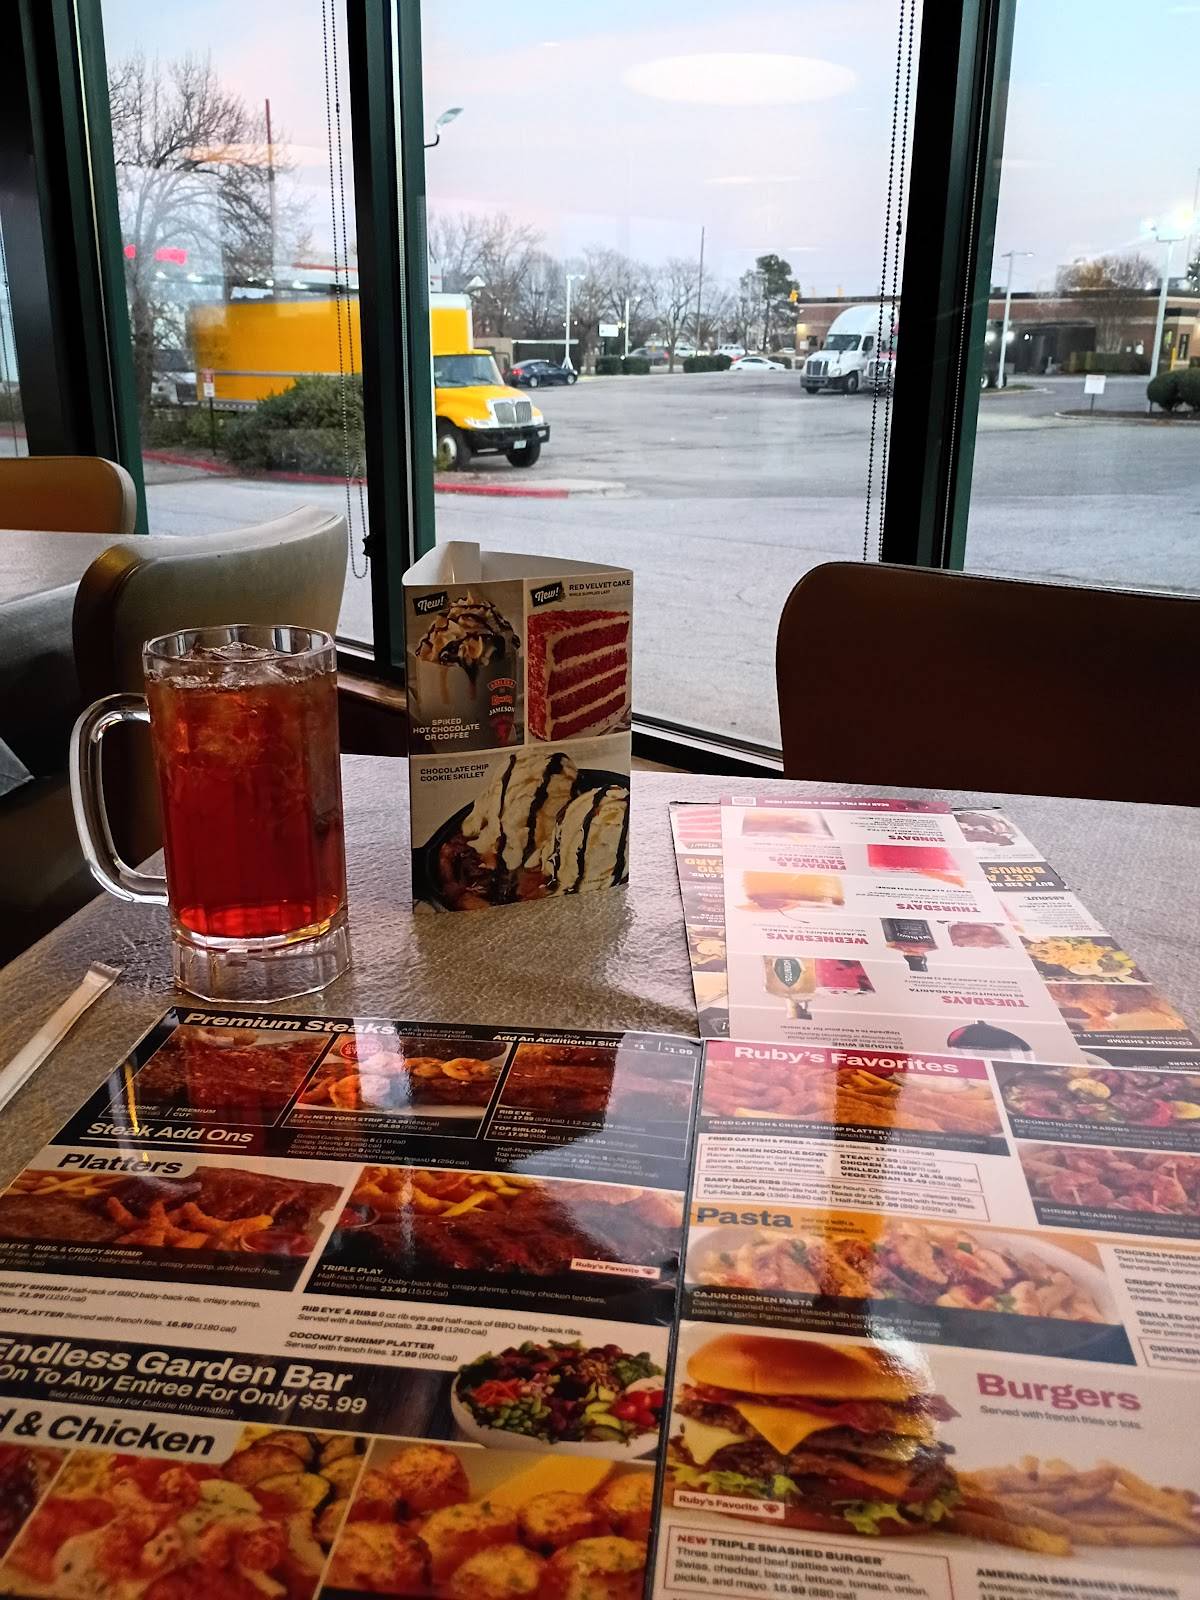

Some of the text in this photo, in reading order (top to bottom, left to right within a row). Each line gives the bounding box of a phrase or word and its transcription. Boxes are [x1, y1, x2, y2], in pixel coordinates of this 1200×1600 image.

[585, 582, 612, 590] VELVET
[612, 580, 631, 588] CAKE
[534, 586, 560, 602] New!
[417, 595, 445, 611] New!
[489, 706, 516, 716] JAMESON
[431, 718, 462, 726] SPIKED
[431, 723, 480, 733] CHOCOLATE
[424, 731, 470, 741] OR COFFEE
[420, 763, 489, 775] CHOCOLATE CHIP
[420, 771, 485, 782] COOKIE SKILLET
[768, 856, 845, 865] SATURDAYS
[792, 861, 847, 870] FRIDAYS
[988, 866, 1046, 874] BONUS
[1004, 874, 1037, 882] GET
[896, 903, 981, 913] THURSDAYS
[766, 933, 869, 945] WEDNESDAYS
[941, 995, 1029, 1008] TUESDAYS
[183, 1012, 302, 1030] Premium
[304, 1020, 396, 1035] Steaks
[537, 1037, 596, 1046] Additional
[734, 1046, 960, 1073] Ruby's Favorites
[811, 1124, 845, 1132] SHRIMP
[846, 1127, 885, 1135] PLATTER
[1013, 1118, 1091, 1130] DECONSTRUCTED
[87, 1122, 256, 1142] Steak Add Ons
[57, 1152, 184, 1174] Platters
[840, 1166, 880, 1174] GRILLED
[841, 1172, 900, 1181] VEGETARIAN
[697, 1206, 795, 1229] Pasta
[1040, 1207, 1117, 1220] SHRIMP SCAMPI
[68, 1246, 143, 1257] CRISPY SHRIMP
[1113, 1248, 1160, 1257] CHICKEN
[321, 1264, 383, 1275] TRIPLE PLAY
[575, 1261, 640, 1274] Ruby's Favorite
[388, 1278, 571, 1299] baby-back crispy crispy chicken
[1124, 1278, 1162, 1287] CRISPY
[28, 1283, 229, 1306] SHRIMP baby-back crispy
[380, 1286, 408, 1294] 23.49
[693, 1291, 813, 1307] CAJUN CHICKEN PASTA
[17, 1308, 194, 1329] PLATTER 16.99
[353, 1308, 378, 1317] RIBS
[1136, 1311, 1183, 1320] GRILLED
[297, 1314, 444, 1332] Served baked 23.99
[289, 1331, 435, 1350] COCONUT SHRIMP PLATTER
[284, 1340, 418, 1358] Served french 17.99
[0, 1337, 353, 1392] Endless Garden Bar
[0, 1364, 368, 1414] On To Any Entree For Only $5.99
[976, 1371, 1142, 1412] Burgers
[68, 1391, 236, 1415] Garden Calorie Information
[980, 1405, 1106, 1427] Served with french fries
[13, 1410, 216, 1456] & Chicken
[678, 1494, 760, 1512] Ruby's Favorite
[677, 1534, 883, 1566] NEW TRIPLE SMASHED BURGER
[676, 1546, 914, 1583] Three smashed beef patties with American,
[673, 1573, 769, 1592] pickle, and mayo.
[675, 1558, 930, 1598] Swiss, cheddar, bacon, lettuce, tomato, onion,
[976, 1568, 1179, 1599] AMERICAN SMASHED BURGER
